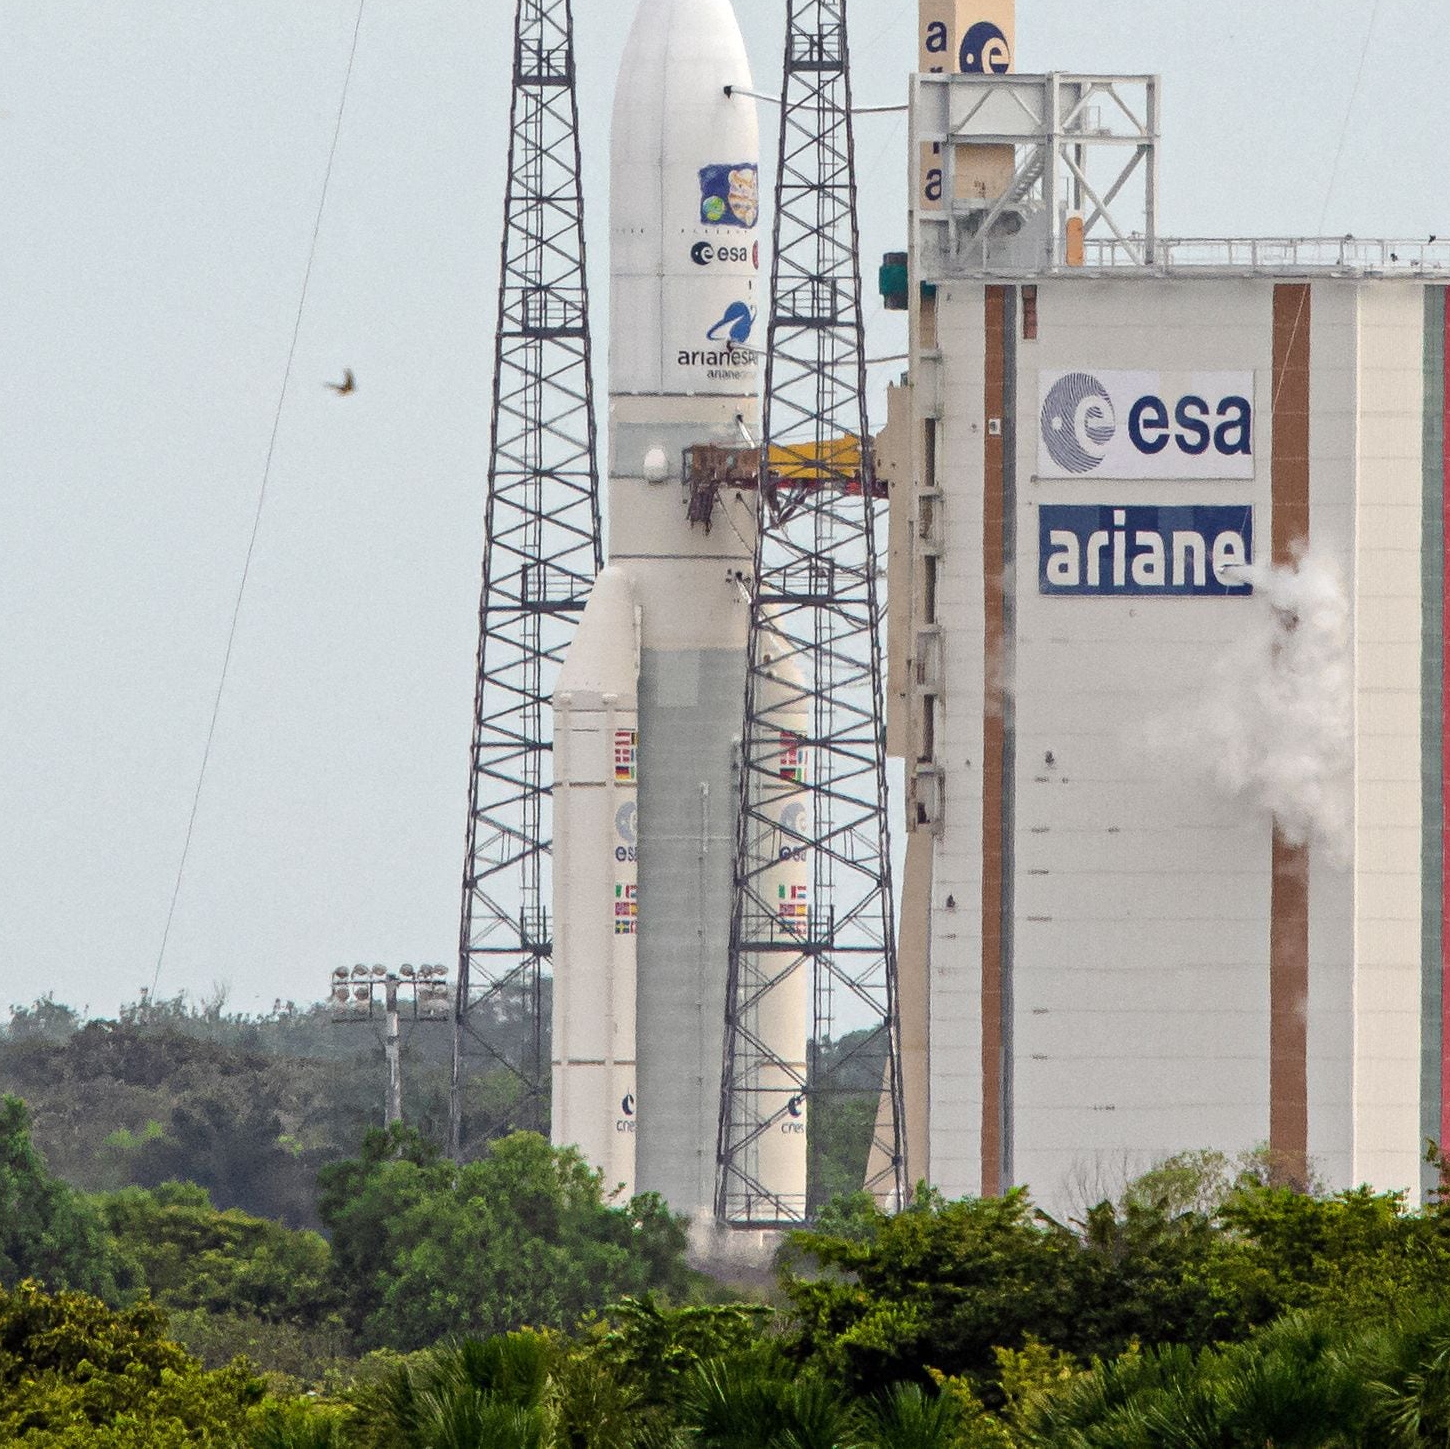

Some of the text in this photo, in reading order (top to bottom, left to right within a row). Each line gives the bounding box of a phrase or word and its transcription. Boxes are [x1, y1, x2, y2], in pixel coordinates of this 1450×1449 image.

[717, 247, 747, 262] esa
[1128, 395, 1252, 455] esa
[1047, 509, 1247, 587] ariane
